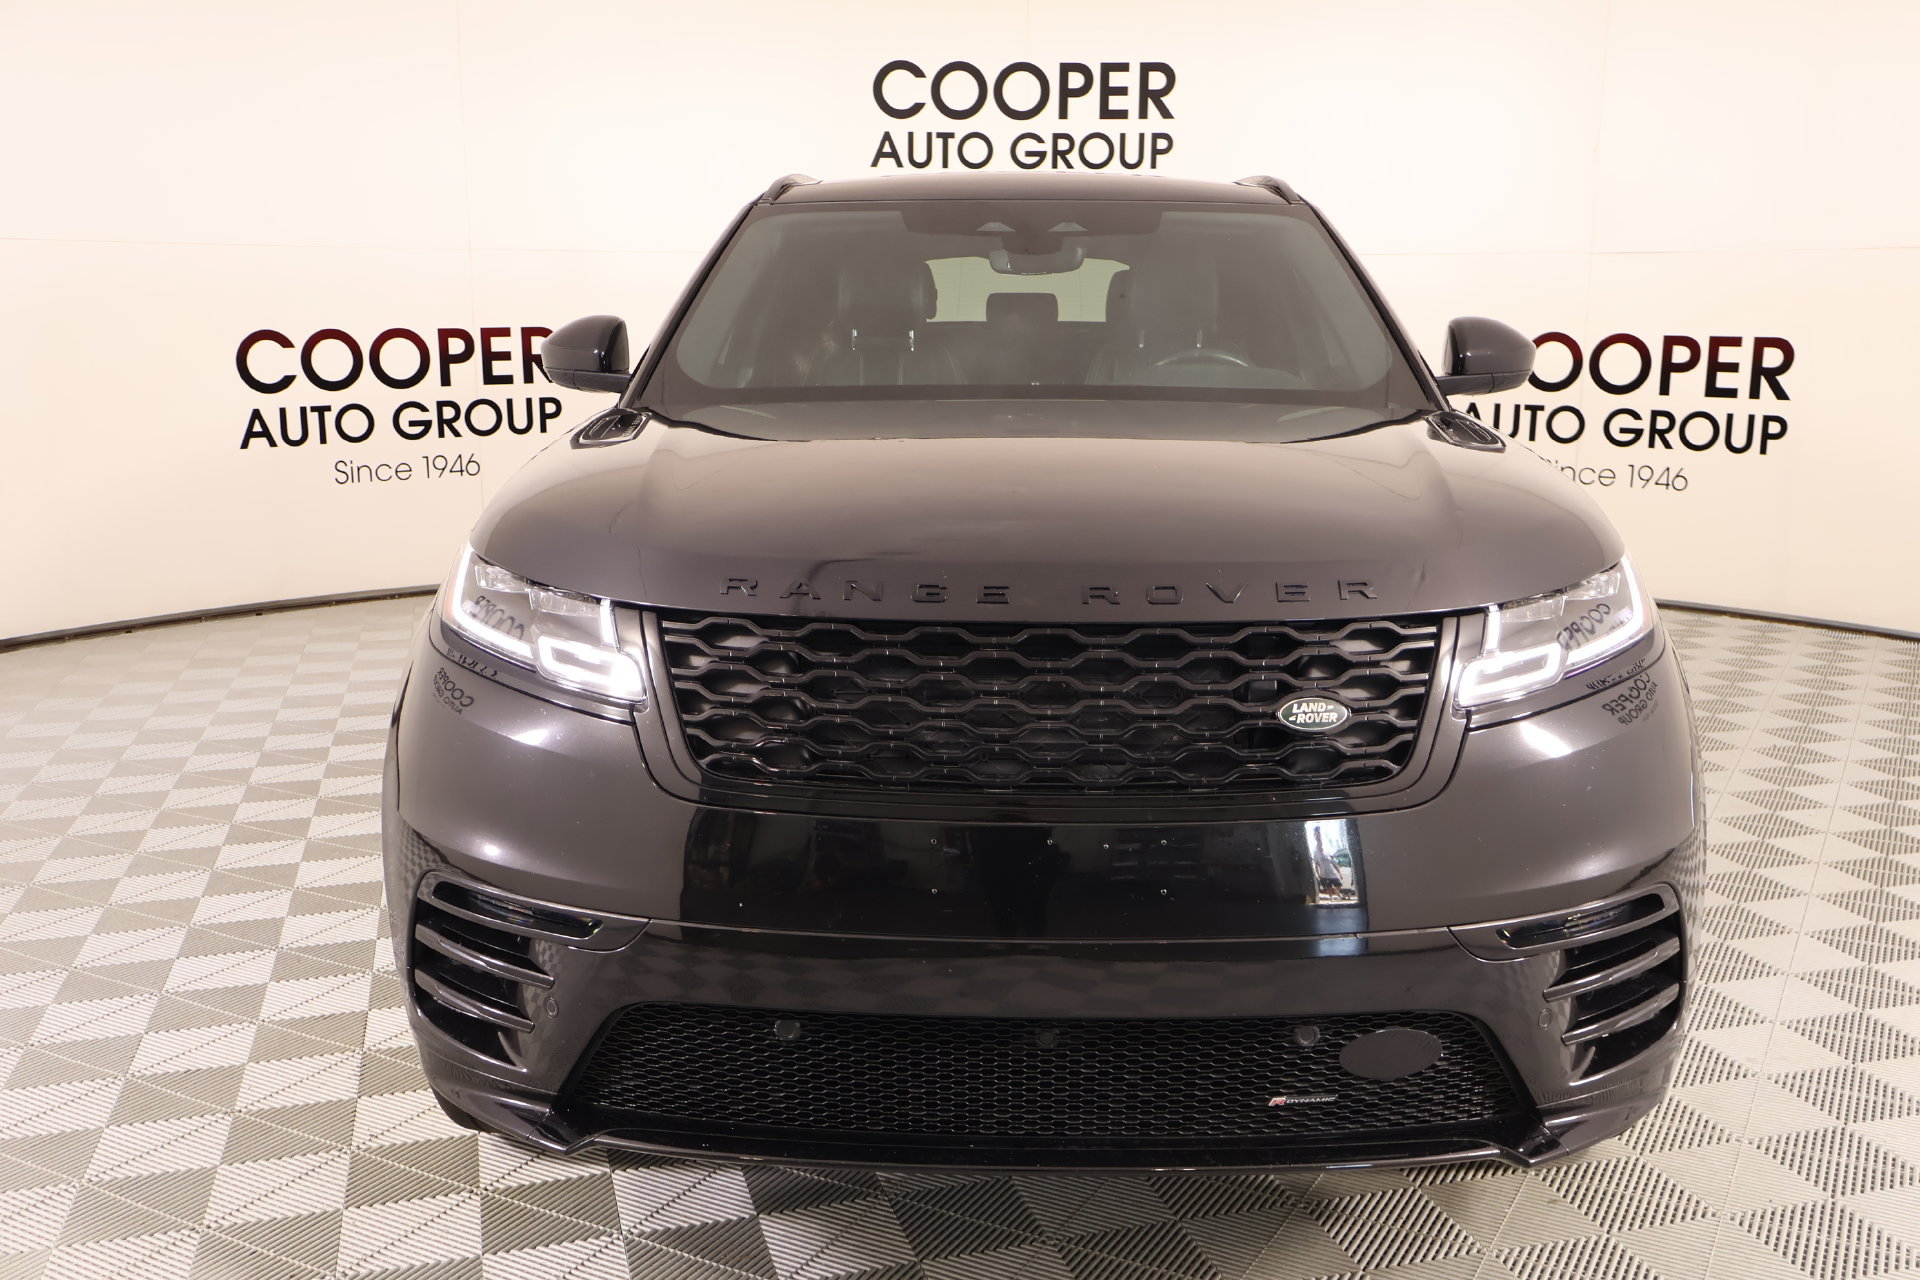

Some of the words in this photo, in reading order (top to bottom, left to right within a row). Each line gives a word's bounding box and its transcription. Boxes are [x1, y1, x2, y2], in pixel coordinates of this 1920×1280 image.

[873, 59, 1176, 121] COOPER
[870, 131, 994, 170] AUTO
[1010, 131, 1174, 170] GROUP
[235, 326, 555, 395] COOPER
[1527, 331, 1795, 401] OOPER
[240, 403, 375, 450] AUTO
[392, 396, 563, 441] GROUP
[1603, 407, 1788, 456] GROUP
[334, 459, 413, 485] Since
[422, 453, 481, 479] 1946
[1547, 459, 1617, 487] nce
[1628, 463, 1689, 492] 1946
[719, 576, 1011, 605] RANGE
[1081, 578, 1378, 606] ROVER
[1291, 702, 1327, 714] LAND
[1296, 712, 1339, 724] ROVER
